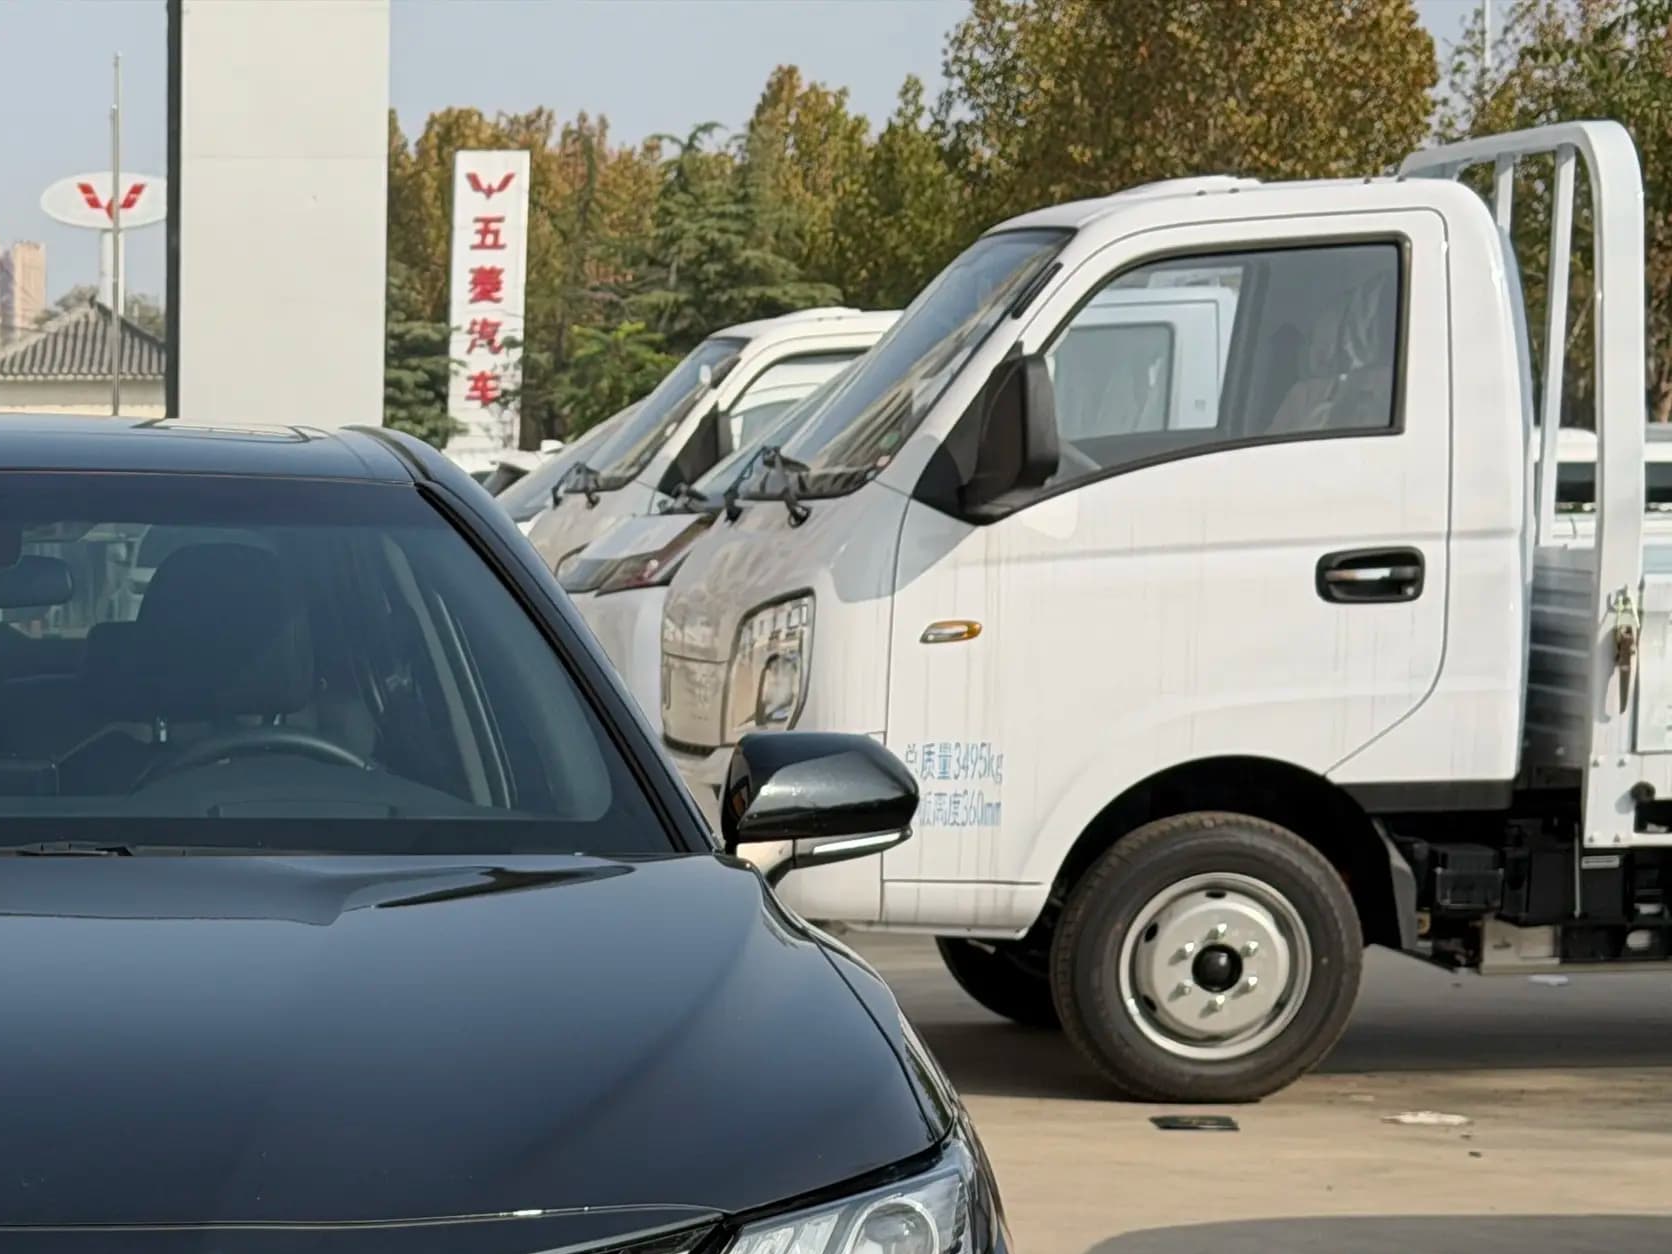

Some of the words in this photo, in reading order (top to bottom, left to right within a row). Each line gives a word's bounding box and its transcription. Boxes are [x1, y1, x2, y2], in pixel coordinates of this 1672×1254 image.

[465, 215, 506, 407] 五菱汽车
[916, 789, 1002, 827] 板高度360mm
